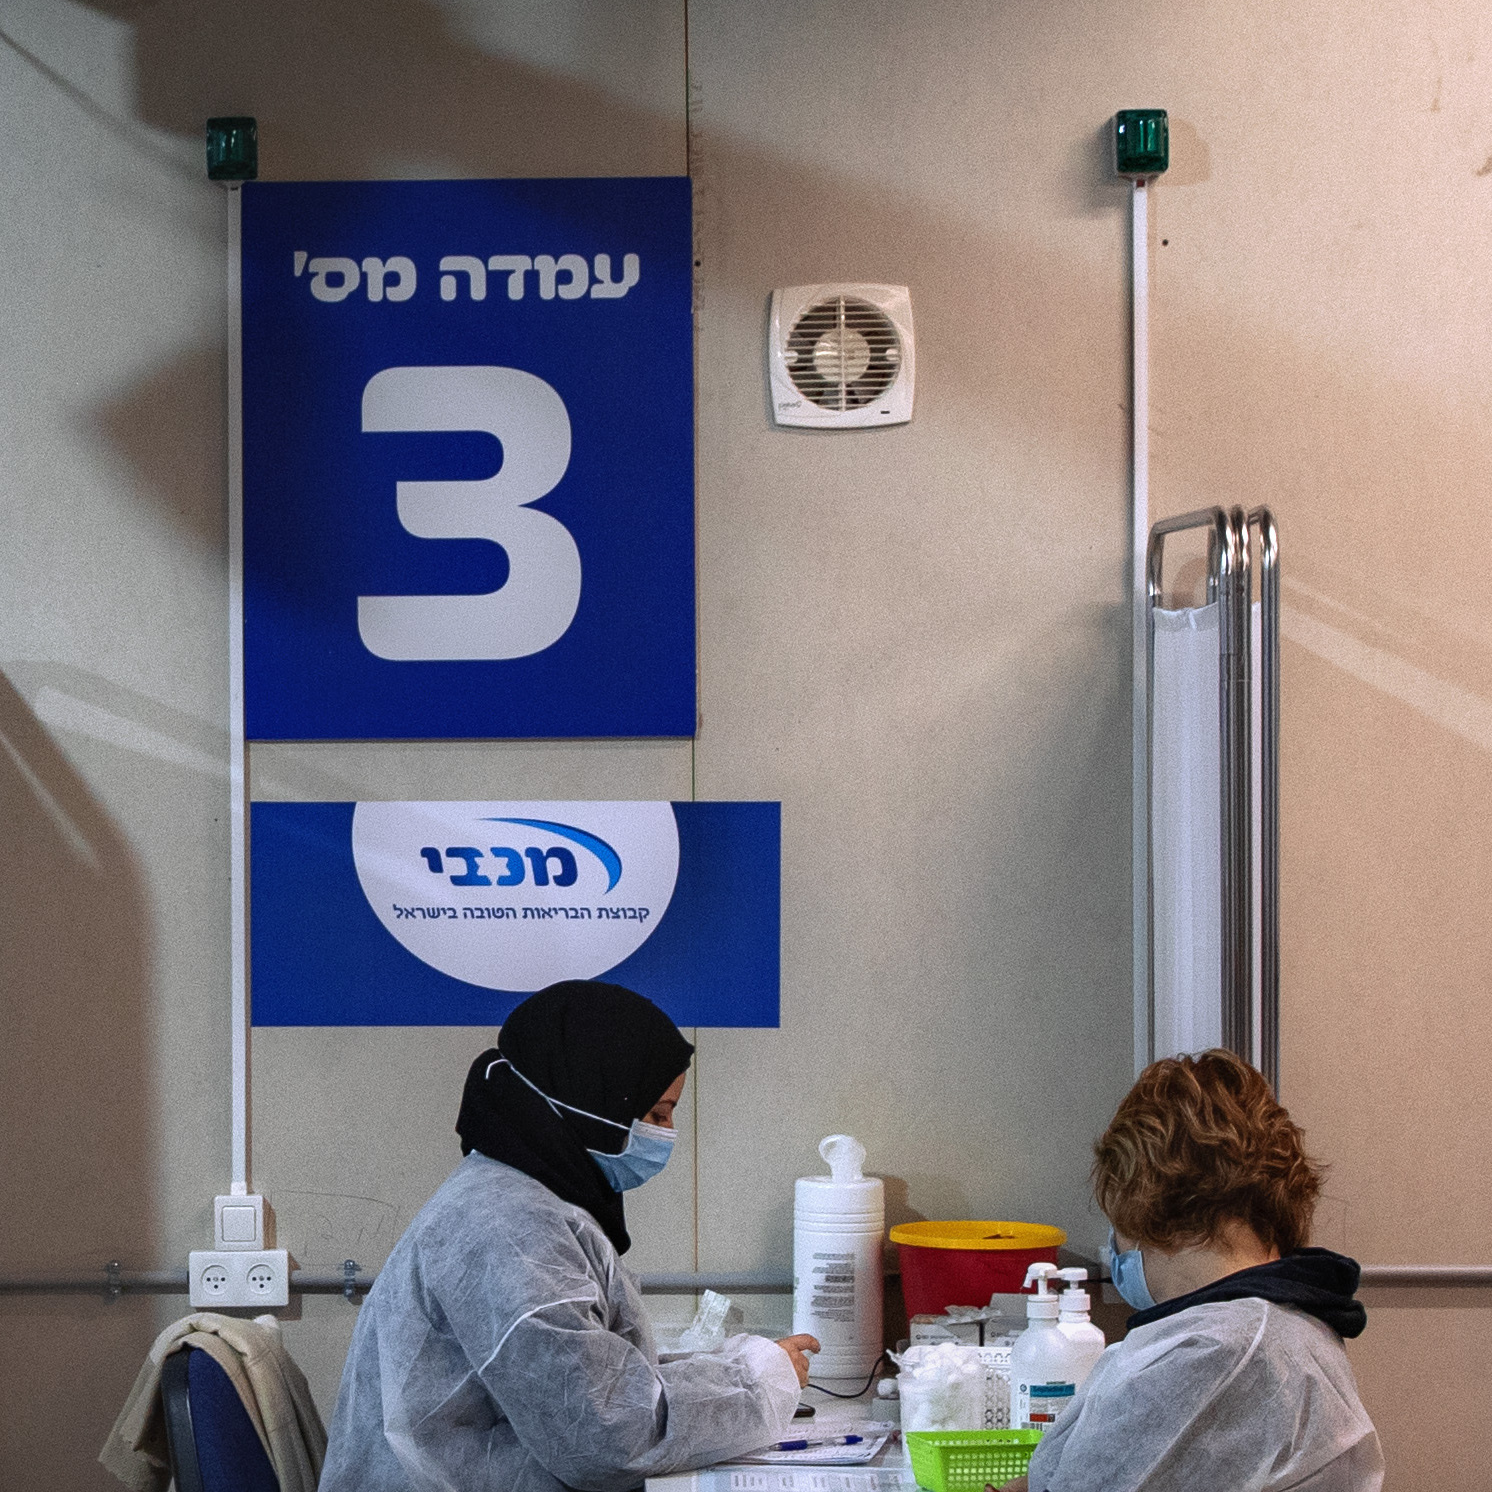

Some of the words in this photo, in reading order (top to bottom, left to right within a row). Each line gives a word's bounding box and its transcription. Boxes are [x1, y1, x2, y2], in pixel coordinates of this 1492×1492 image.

[294, 251, 417, 302] מס'
[440, 253, 640, 301] עמדה
[357, 365, 582, 662] 3
[420, 846, 578, 887] מכבי
[392, 903, 458, 920] בישראל
[462, 907, 517, 920] הטובה
[522, 907, 593, 919] הבריאות
[597, 907, 651, 924] קבוצת
